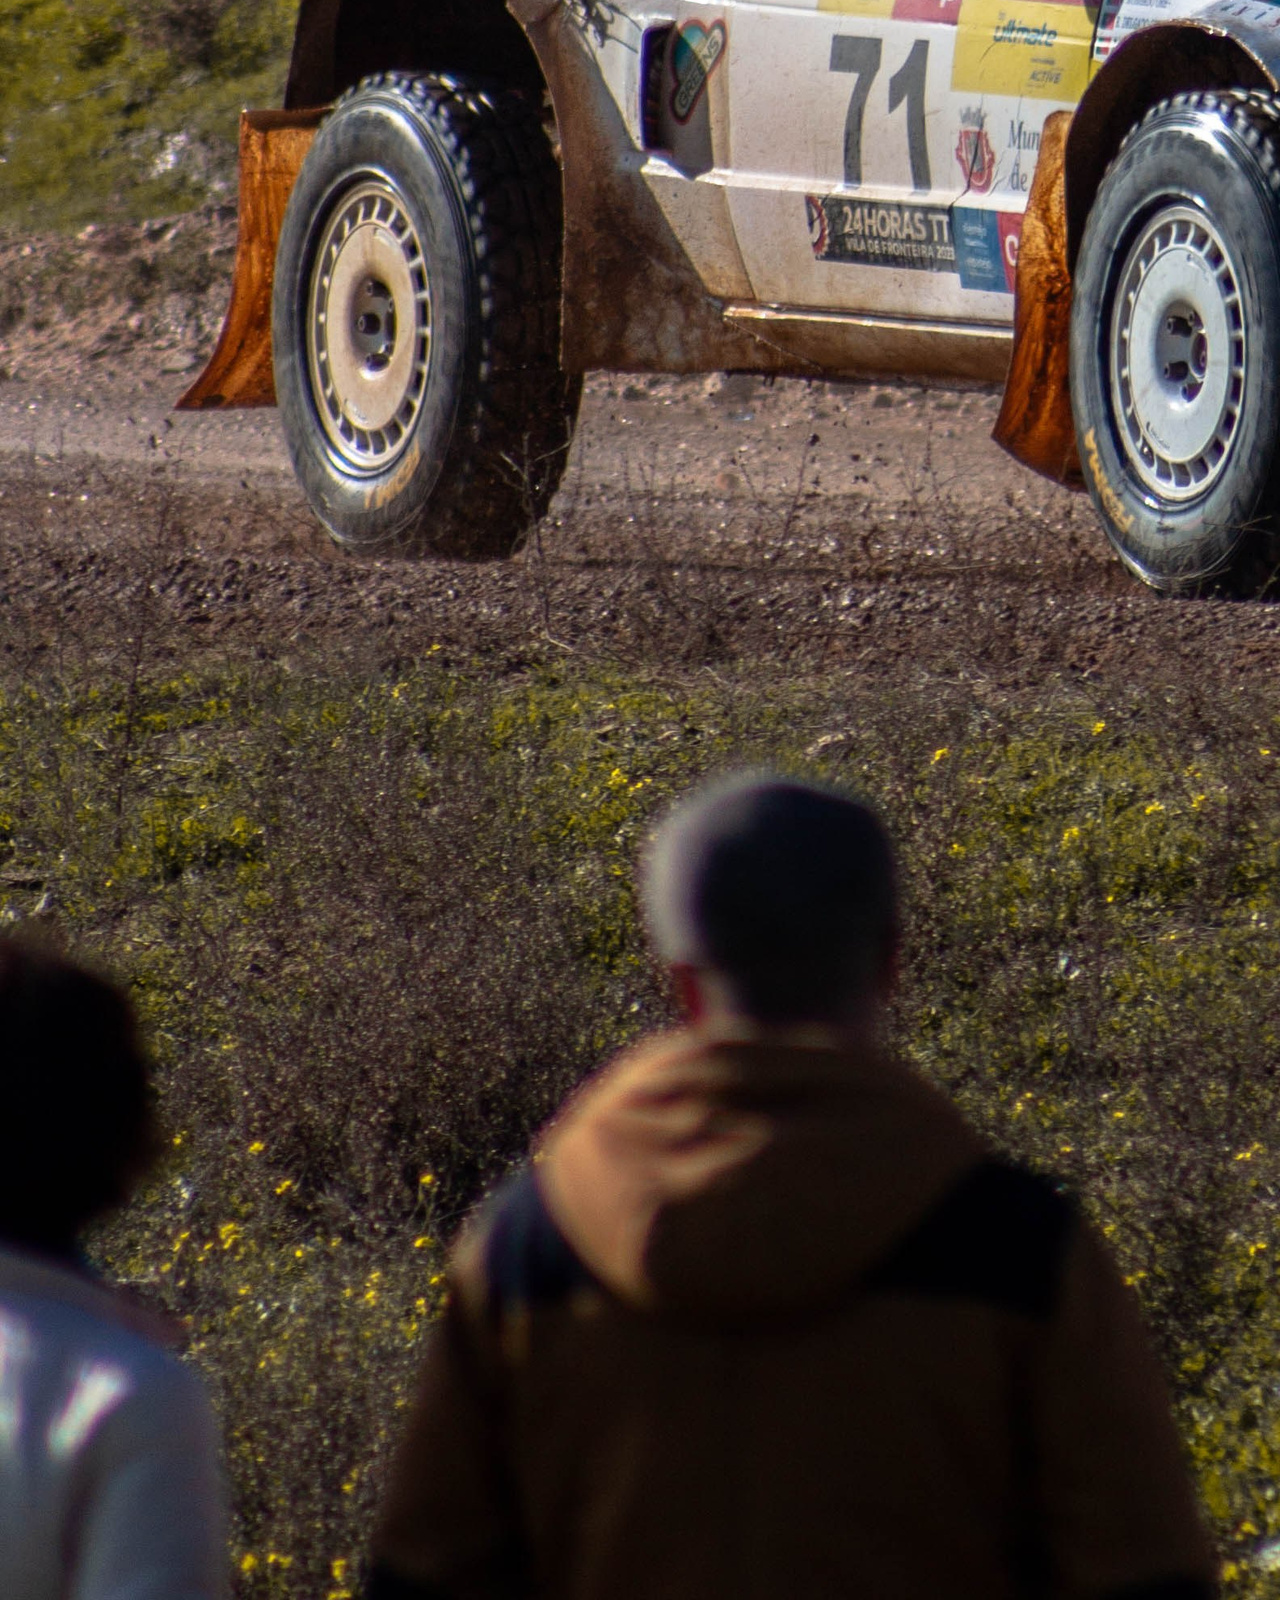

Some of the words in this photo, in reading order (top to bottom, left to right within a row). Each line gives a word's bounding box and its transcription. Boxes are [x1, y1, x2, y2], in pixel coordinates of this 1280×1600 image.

[993, 18, 1058, 47] ultimate
[829, 33, 931, 196] 71
[1010, 163, 1028, 192] de
[928, 213, 949, 242] TT
[845, 236, 867, 253] VILA
[868, 238, 880, 255] DE
[881, 241, 934, 258] FRONTEIRA
